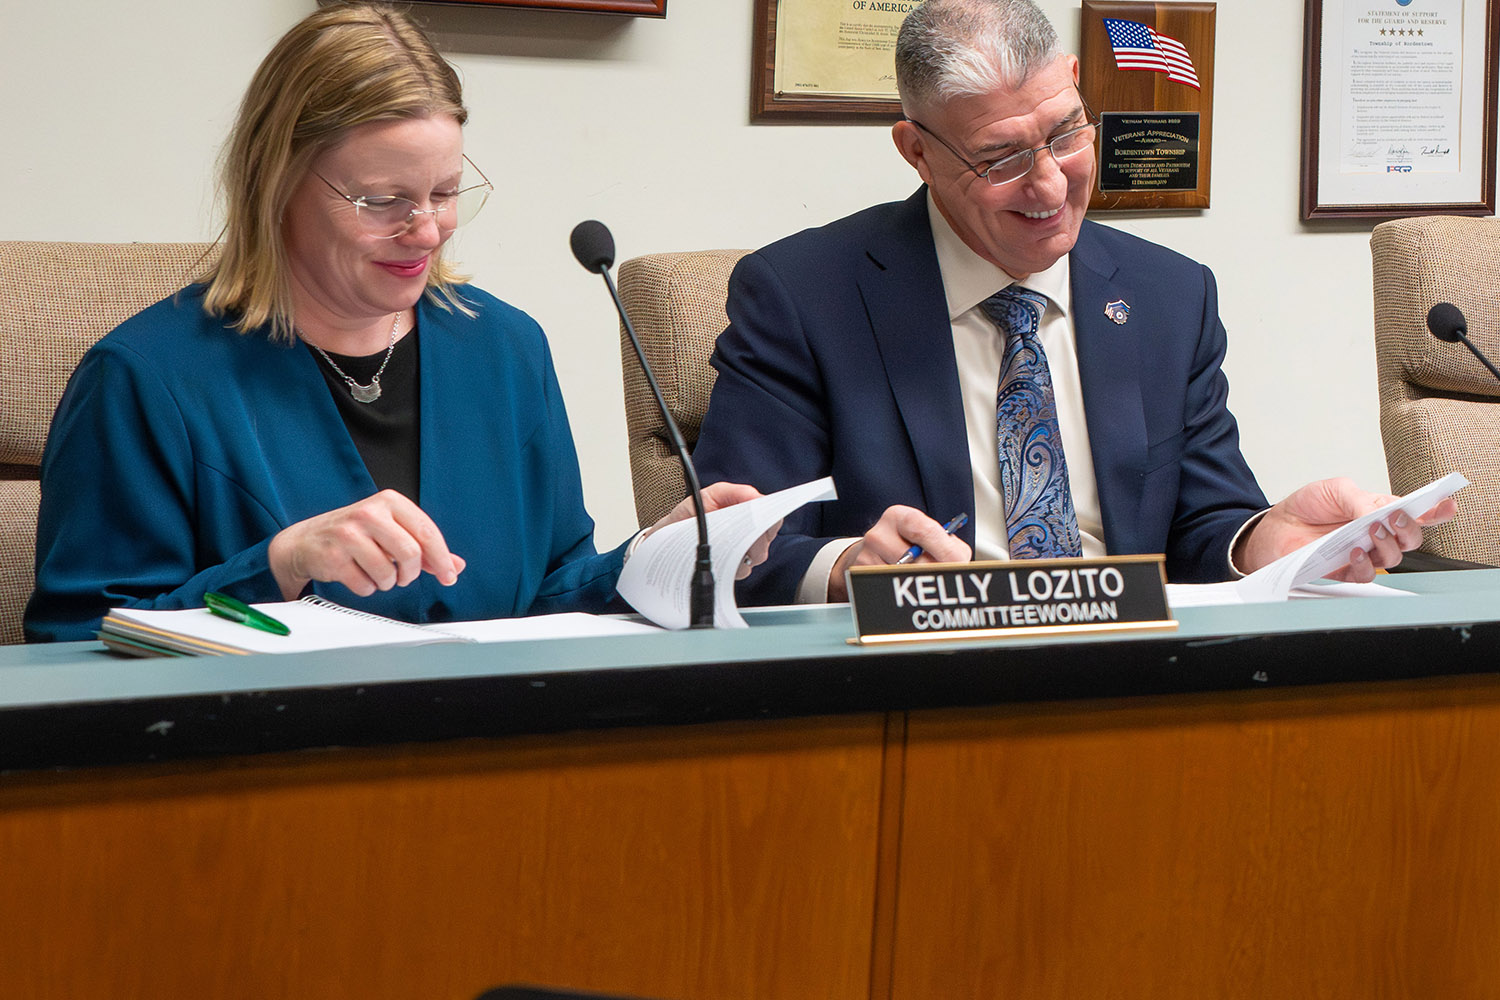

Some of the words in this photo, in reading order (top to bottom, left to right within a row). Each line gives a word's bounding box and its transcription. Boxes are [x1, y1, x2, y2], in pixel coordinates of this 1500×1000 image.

[853, 0, 867, 10] OF
[869, 2, 914, 13] AMERICA
[1112, 131, 1146, 143] VETERANS
[1147, 130, 1190, 144] APPRECIATION
[1156, 148, 1186, 156] TOWNSHIP
[892, 572, 993, 607] KELLY
[1008, 567, 1125, 601] LOZITO
[912, 601, 1118, 630] COMMITTEEWOMAN
